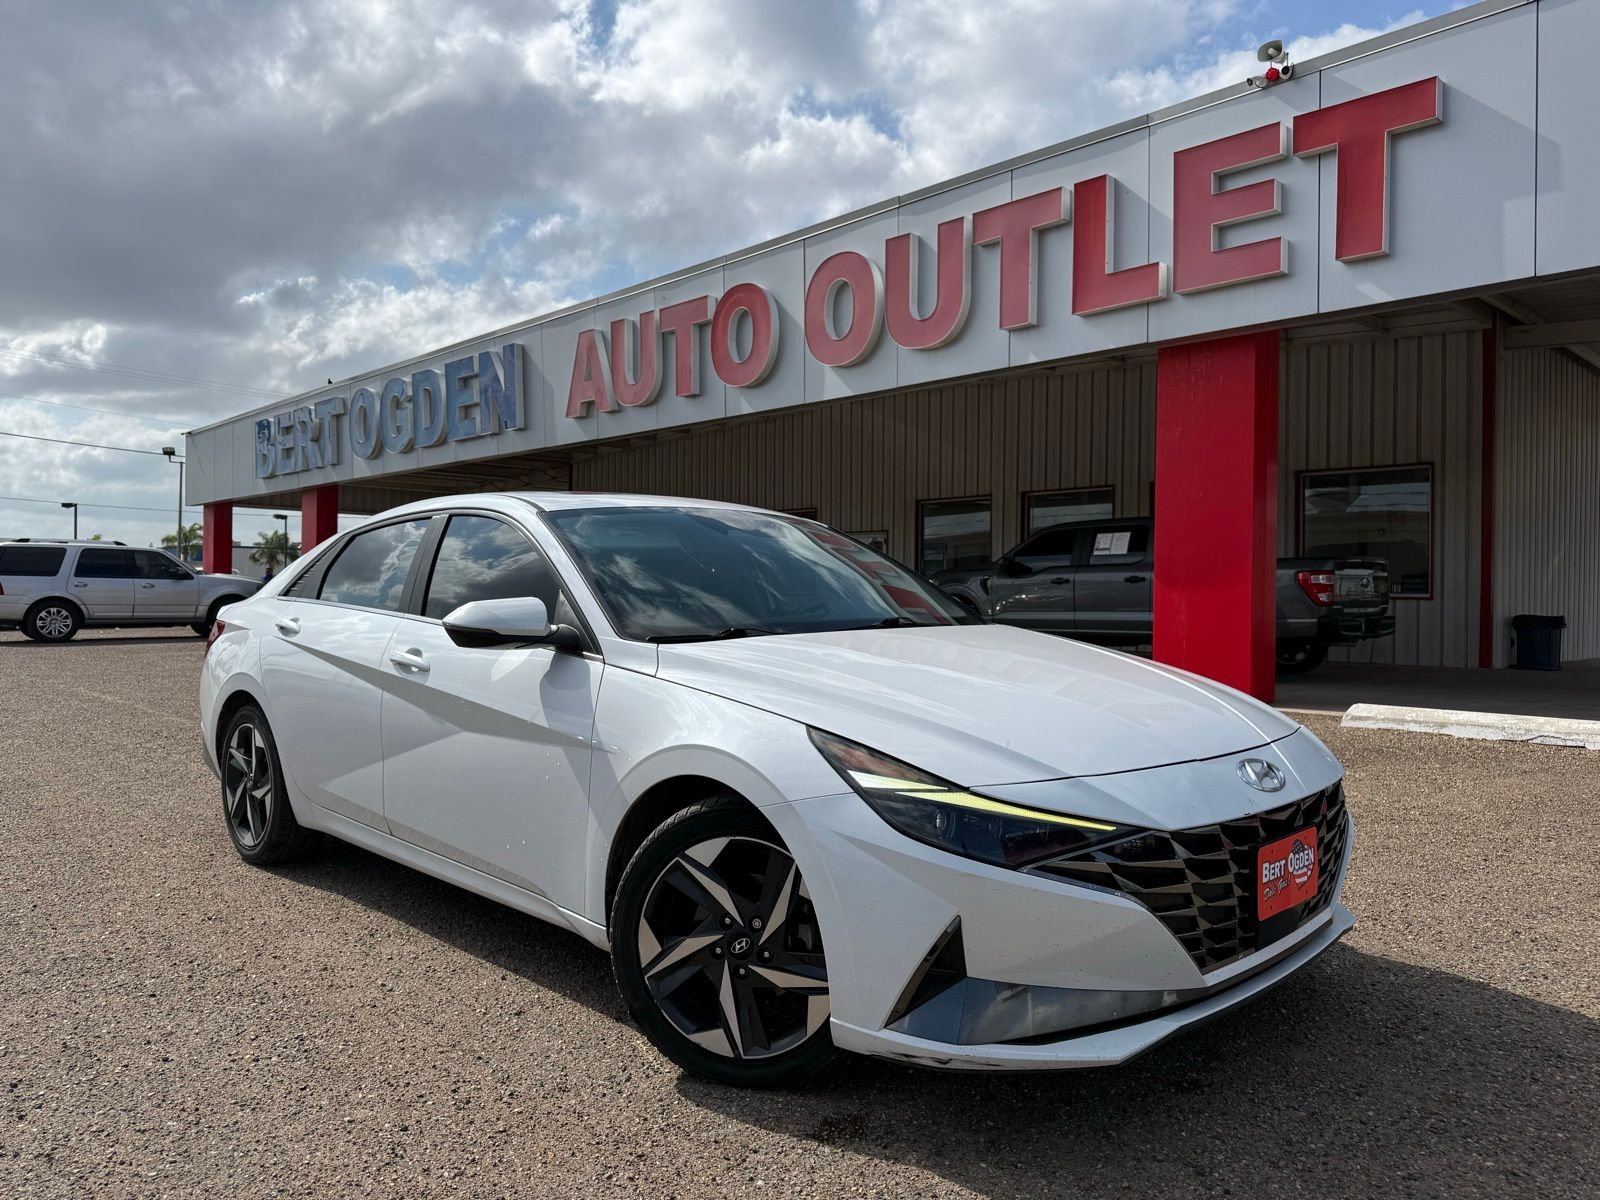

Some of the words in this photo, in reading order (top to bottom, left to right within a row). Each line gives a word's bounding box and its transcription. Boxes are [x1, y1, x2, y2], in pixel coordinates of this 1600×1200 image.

[255, 396, 345, 479] BERT
[350, 343, 525, 460] OGDEN
[565, 282, 780, 420] AUTO
[804, 76, 1444, 368] OUTLET
[1262, 859, 1286, 883] BERT
[1287, 847, 1315, 873] OGDEN
